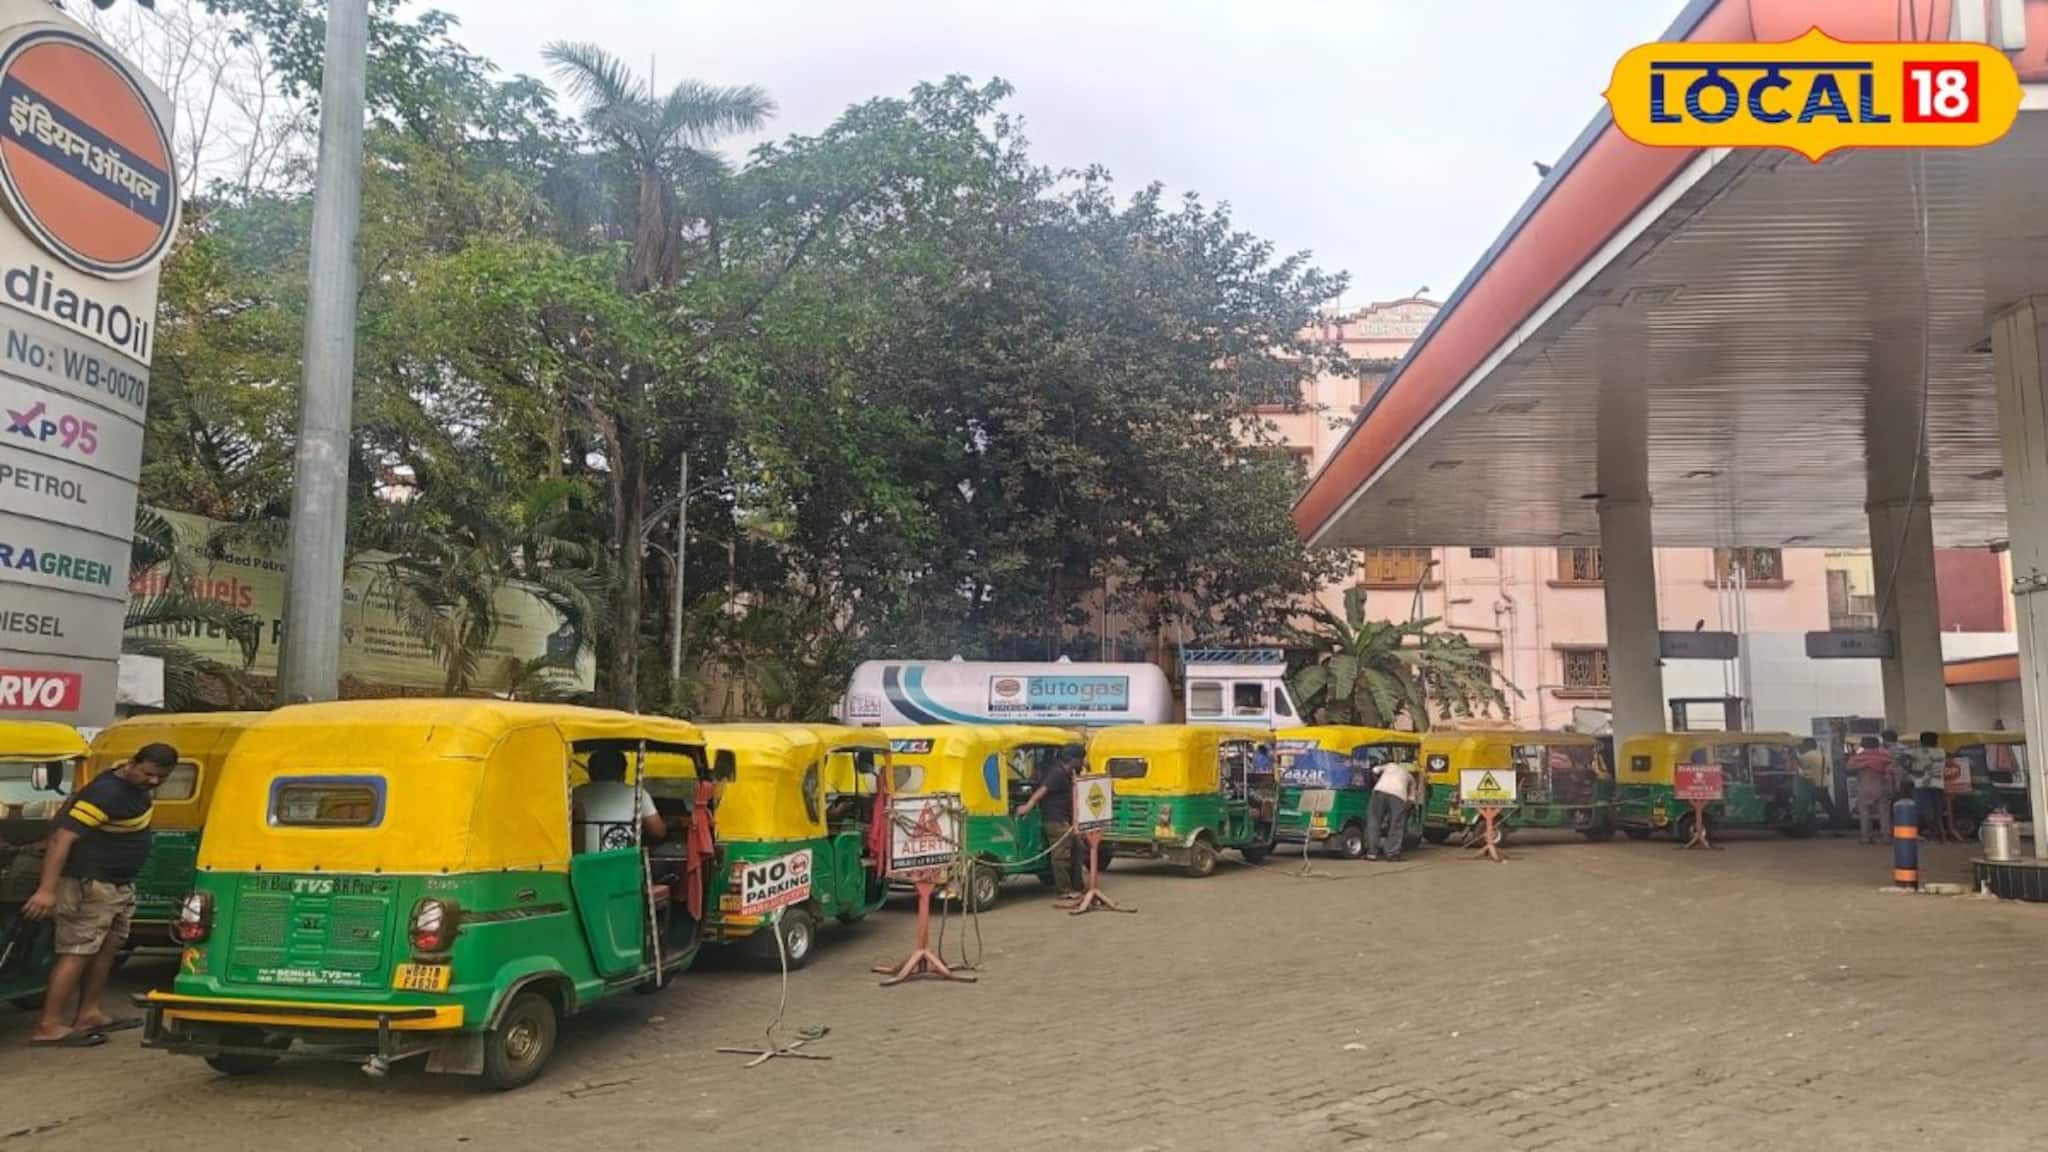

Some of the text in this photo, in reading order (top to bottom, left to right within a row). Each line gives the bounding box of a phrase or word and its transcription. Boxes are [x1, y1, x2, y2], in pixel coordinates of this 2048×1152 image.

[9, 94, 160, 206] इंडियनऑयल
[7, 329, 145, 406] No: WB-0070
[0, 464, 87, 504] PETROL
[0, 611, 64, 637] IESEL
[902, 838, 945, 855] ALERT
[293, 878, 334, 894] TVS
[746, 873, 809, 903] PARKING
[747, 861, 786, 889] NO
